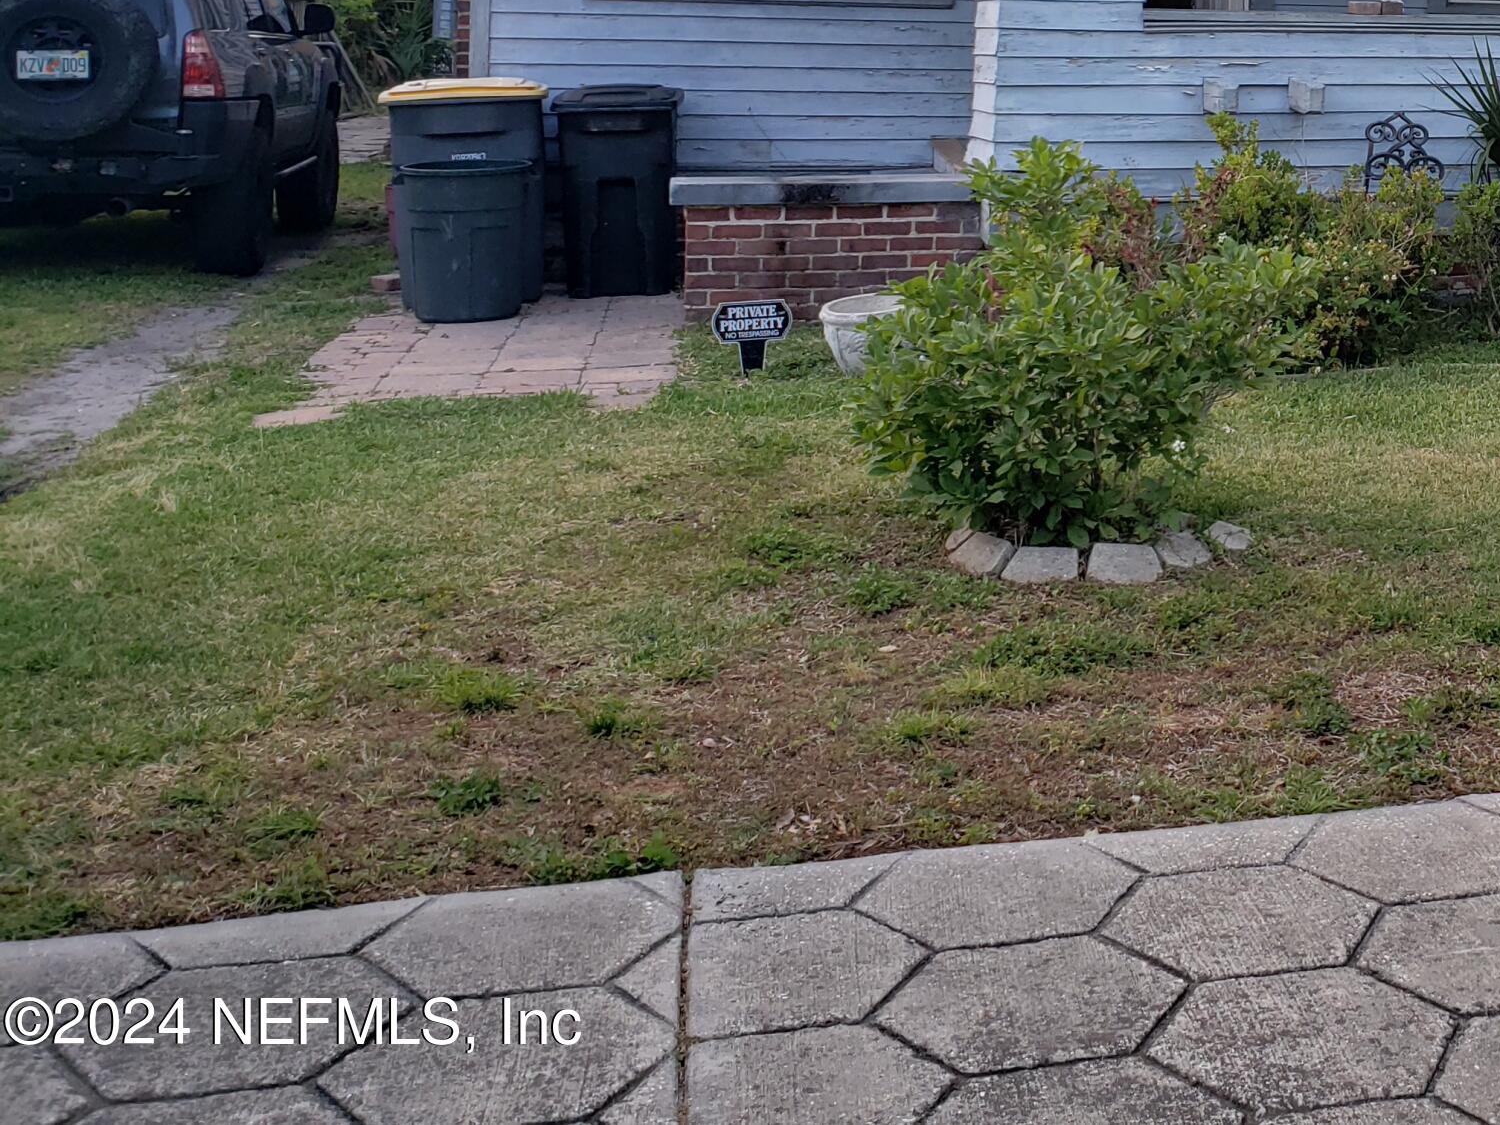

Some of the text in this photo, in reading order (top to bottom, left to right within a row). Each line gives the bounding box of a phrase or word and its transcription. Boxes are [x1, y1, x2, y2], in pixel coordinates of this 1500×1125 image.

[20, 57, 44, 73] KZV
[727, 304, 777, 319] PRIVATE
[719, 316, 785, 332] PROPERTY
[738, 329, 779, 338] TRESPASSING
